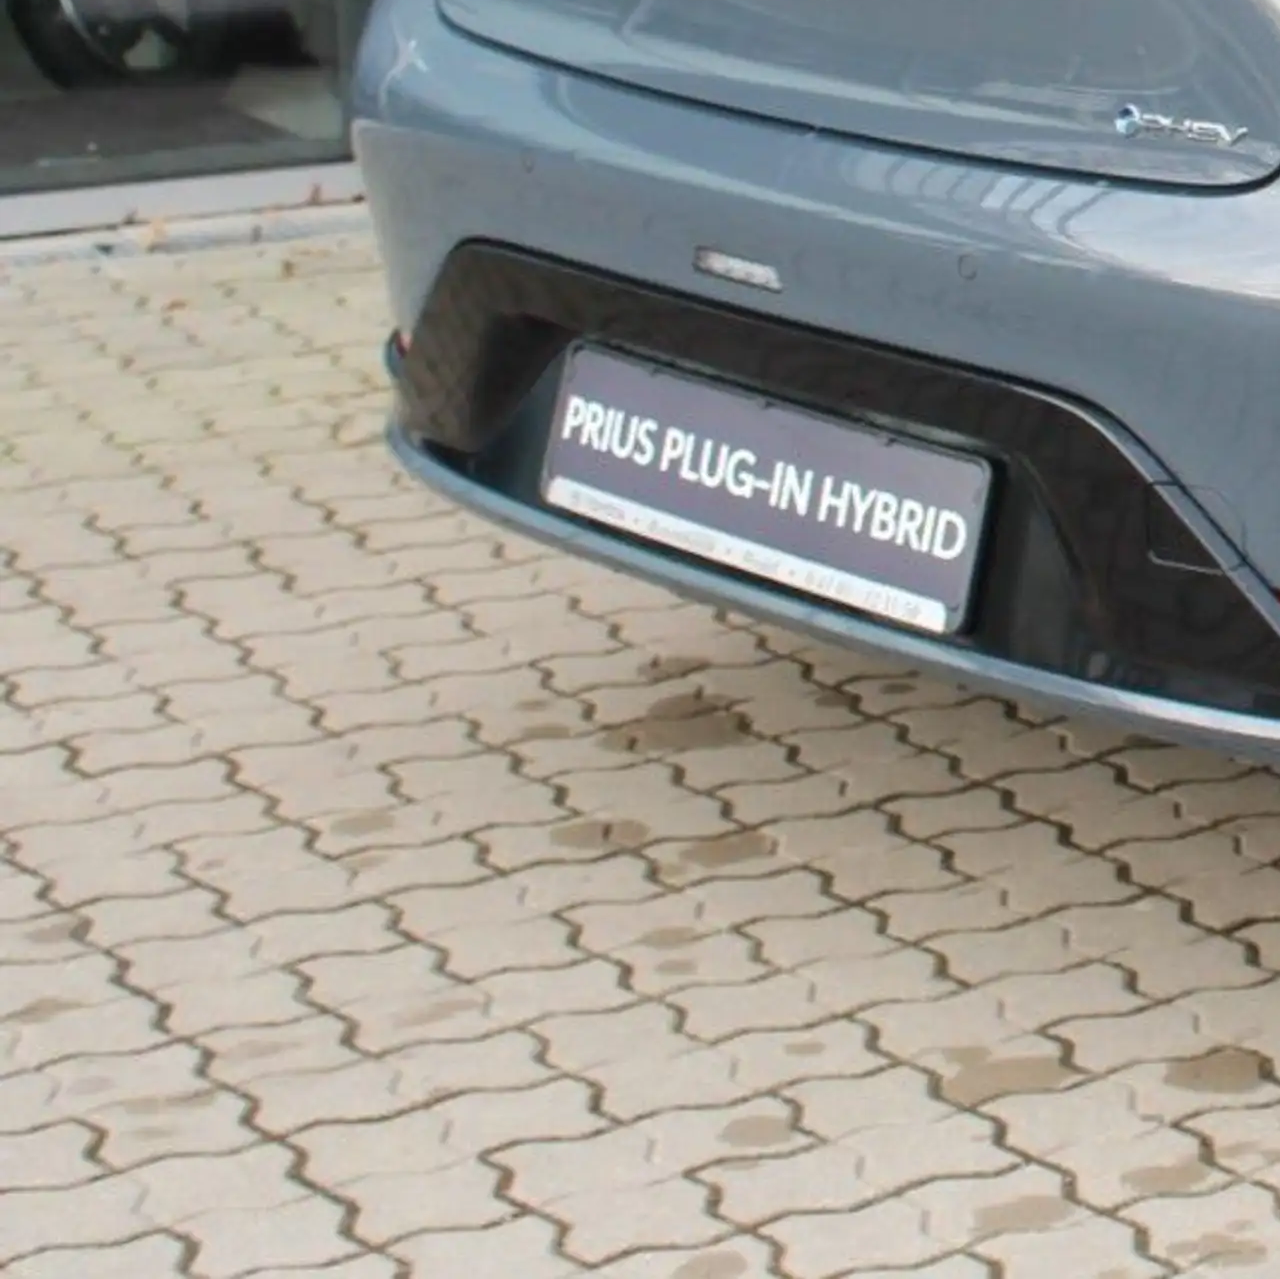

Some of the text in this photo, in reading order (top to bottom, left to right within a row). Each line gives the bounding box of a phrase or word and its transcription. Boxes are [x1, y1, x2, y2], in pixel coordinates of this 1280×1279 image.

[561, 394, 658, 468] PRIUS
[659, 426, 815, 518] PLUG-IN
[817, 474, 967, 562] HYBRID
